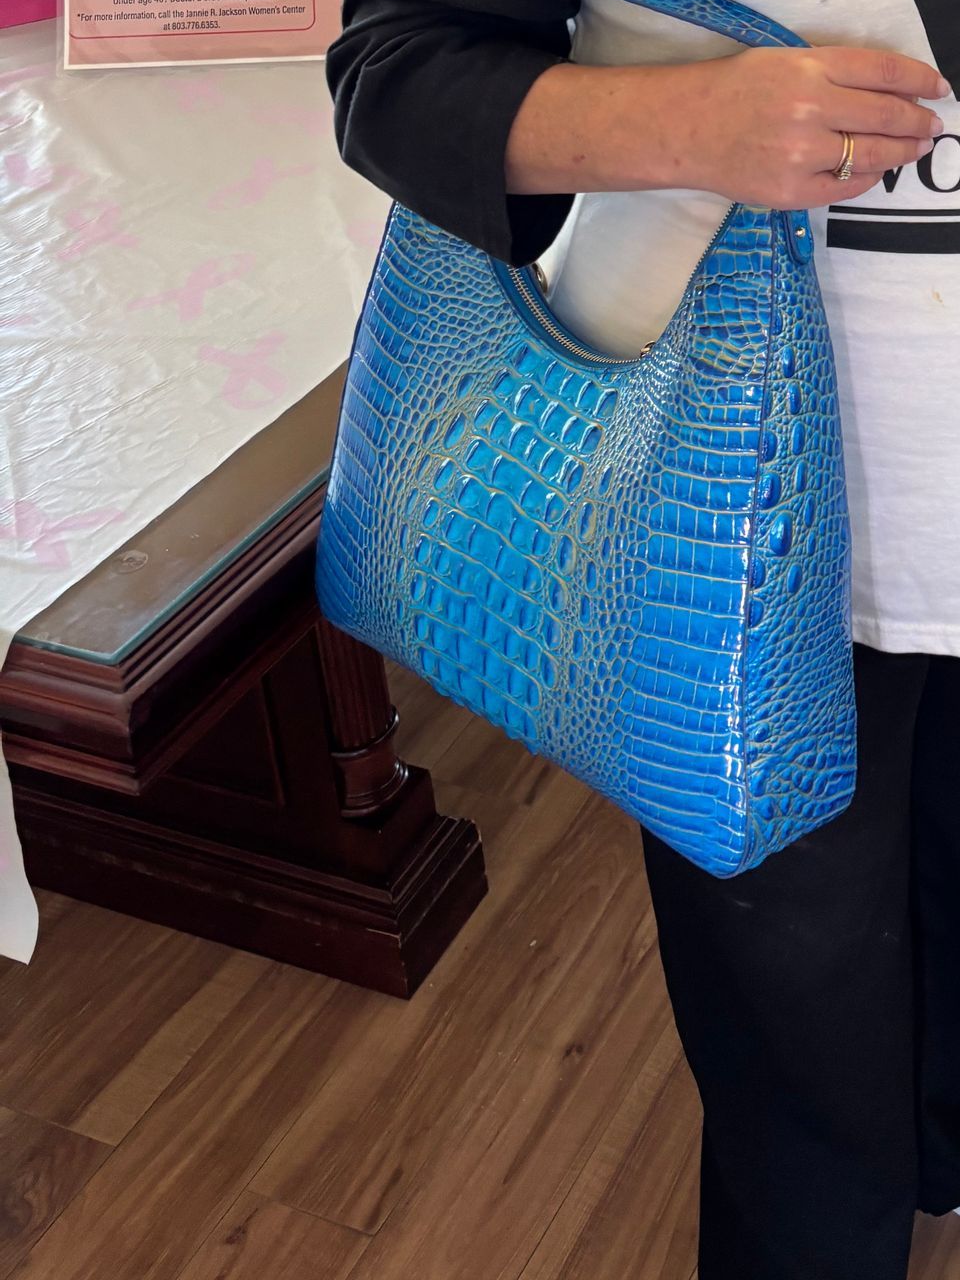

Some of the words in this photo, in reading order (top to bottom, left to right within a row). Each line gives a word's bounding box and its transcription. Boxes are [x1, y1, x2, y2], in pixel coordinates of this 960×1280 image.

[94, 13, 113, 21] more
[114, 11, 157, 21] information,
[157, 10, 171, 19] call
[172, 9, 185, 18] the
[185, 7, 209, 18] Jannie
[210, 8, 218, 17] R.
[218, 6, 247, 17] Jackson
[248, 5, 281, 16] Women's
[282, 4, 306, 14] Center
[163, 22, 171, 31] at
